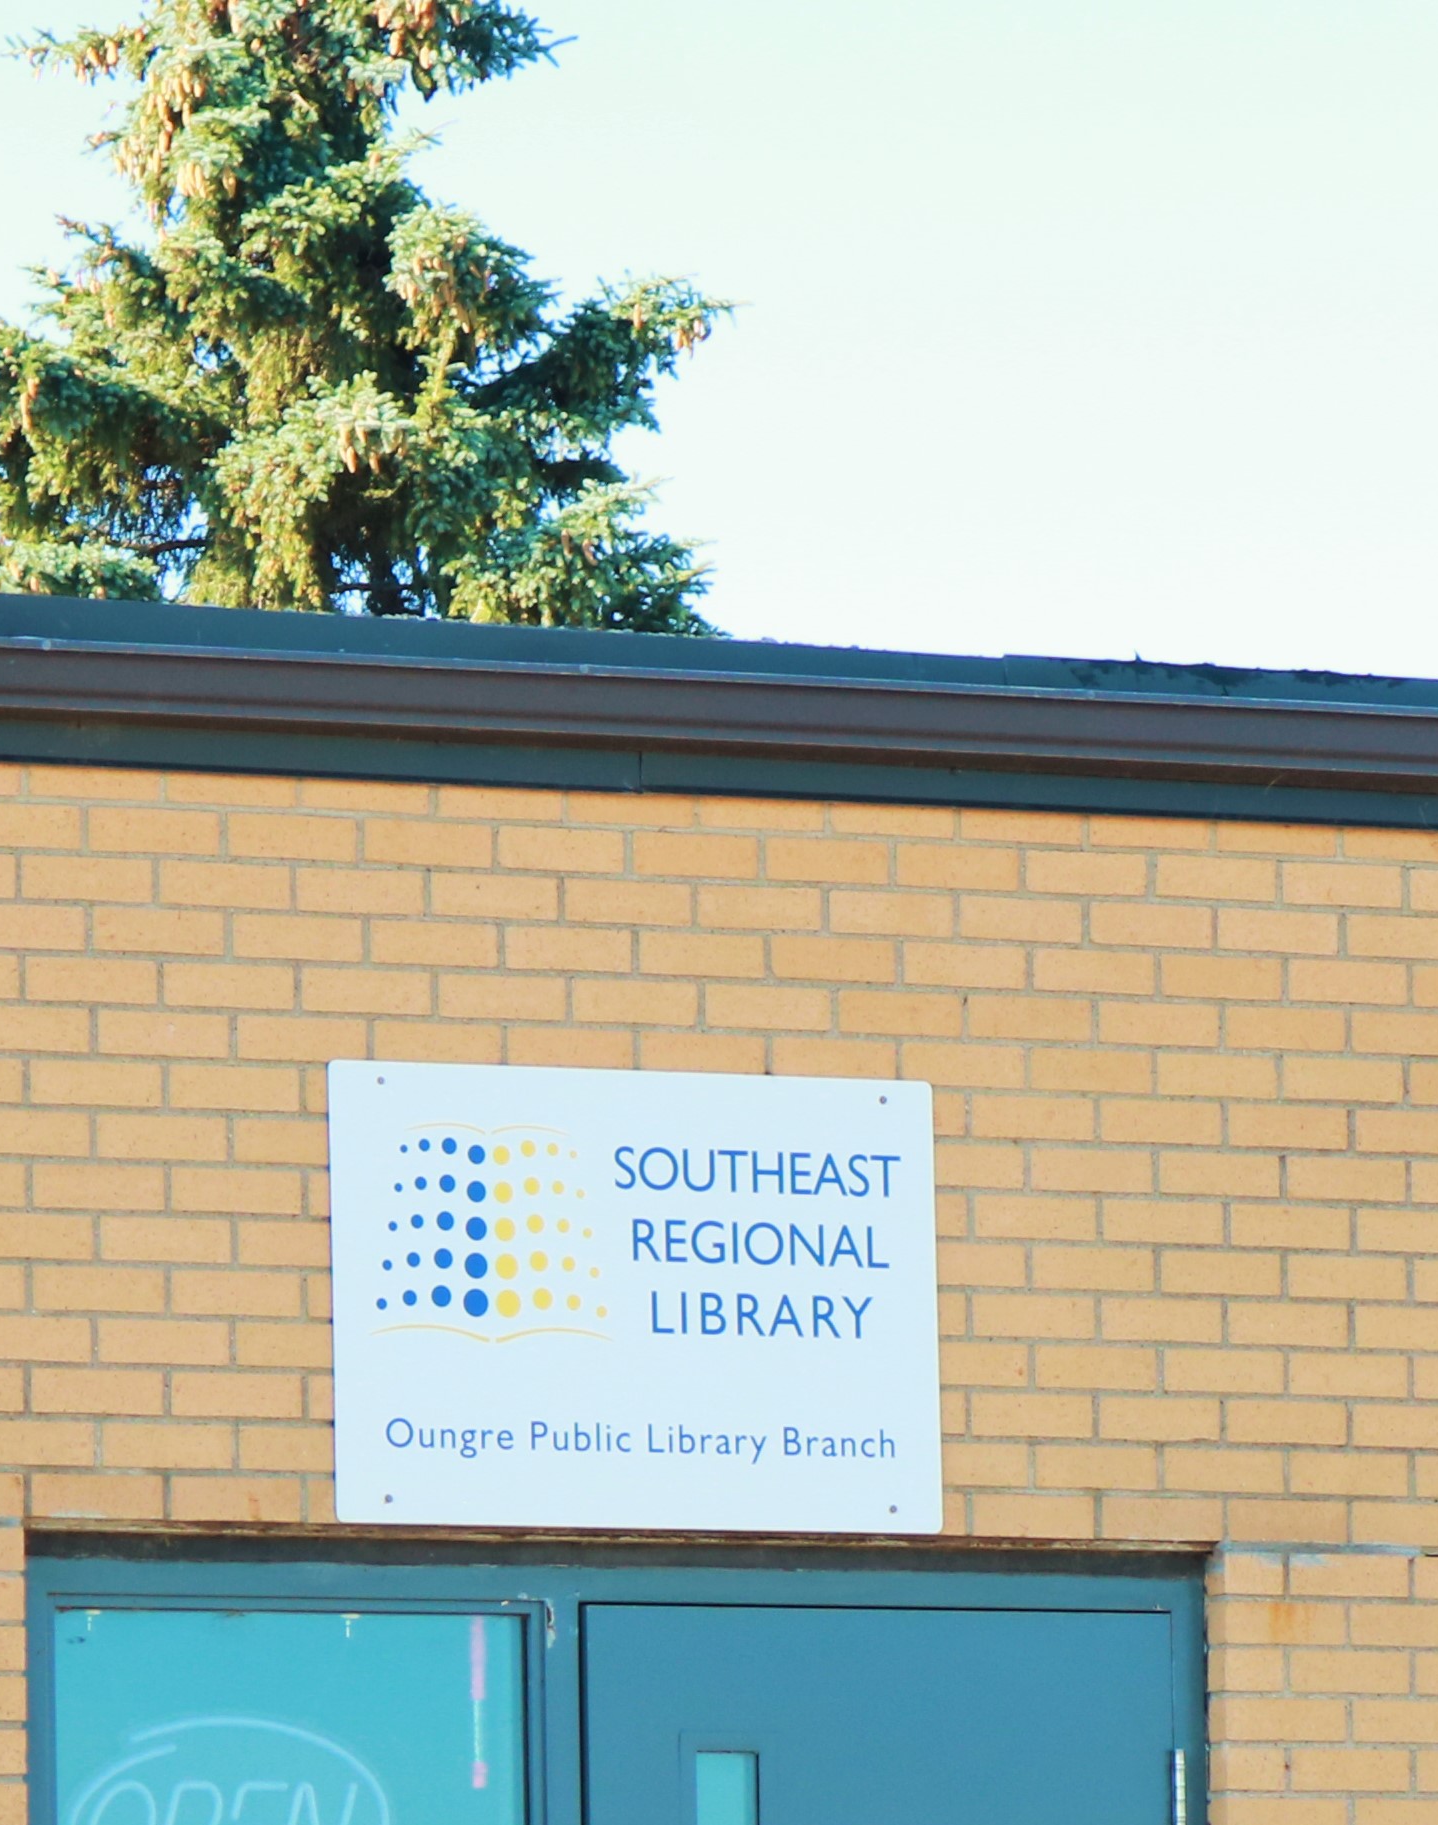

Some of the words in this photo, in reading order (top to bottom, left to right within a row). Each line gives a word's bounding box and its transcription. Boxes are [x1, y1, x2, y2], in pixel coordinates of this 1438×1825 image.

[613, 1145, 902, 1198] SOUTHEAST
[631, 1218, 891, 1269] REGIONAL
[650, 1290, 874, 1339] LIBRARY
[385, 1417, 515, 1459] Oungre
[530, 1420, 632, 1453] Public
[646, 1423, 767, 1465] Library
[783, 1426, 896, 1458] Branch
